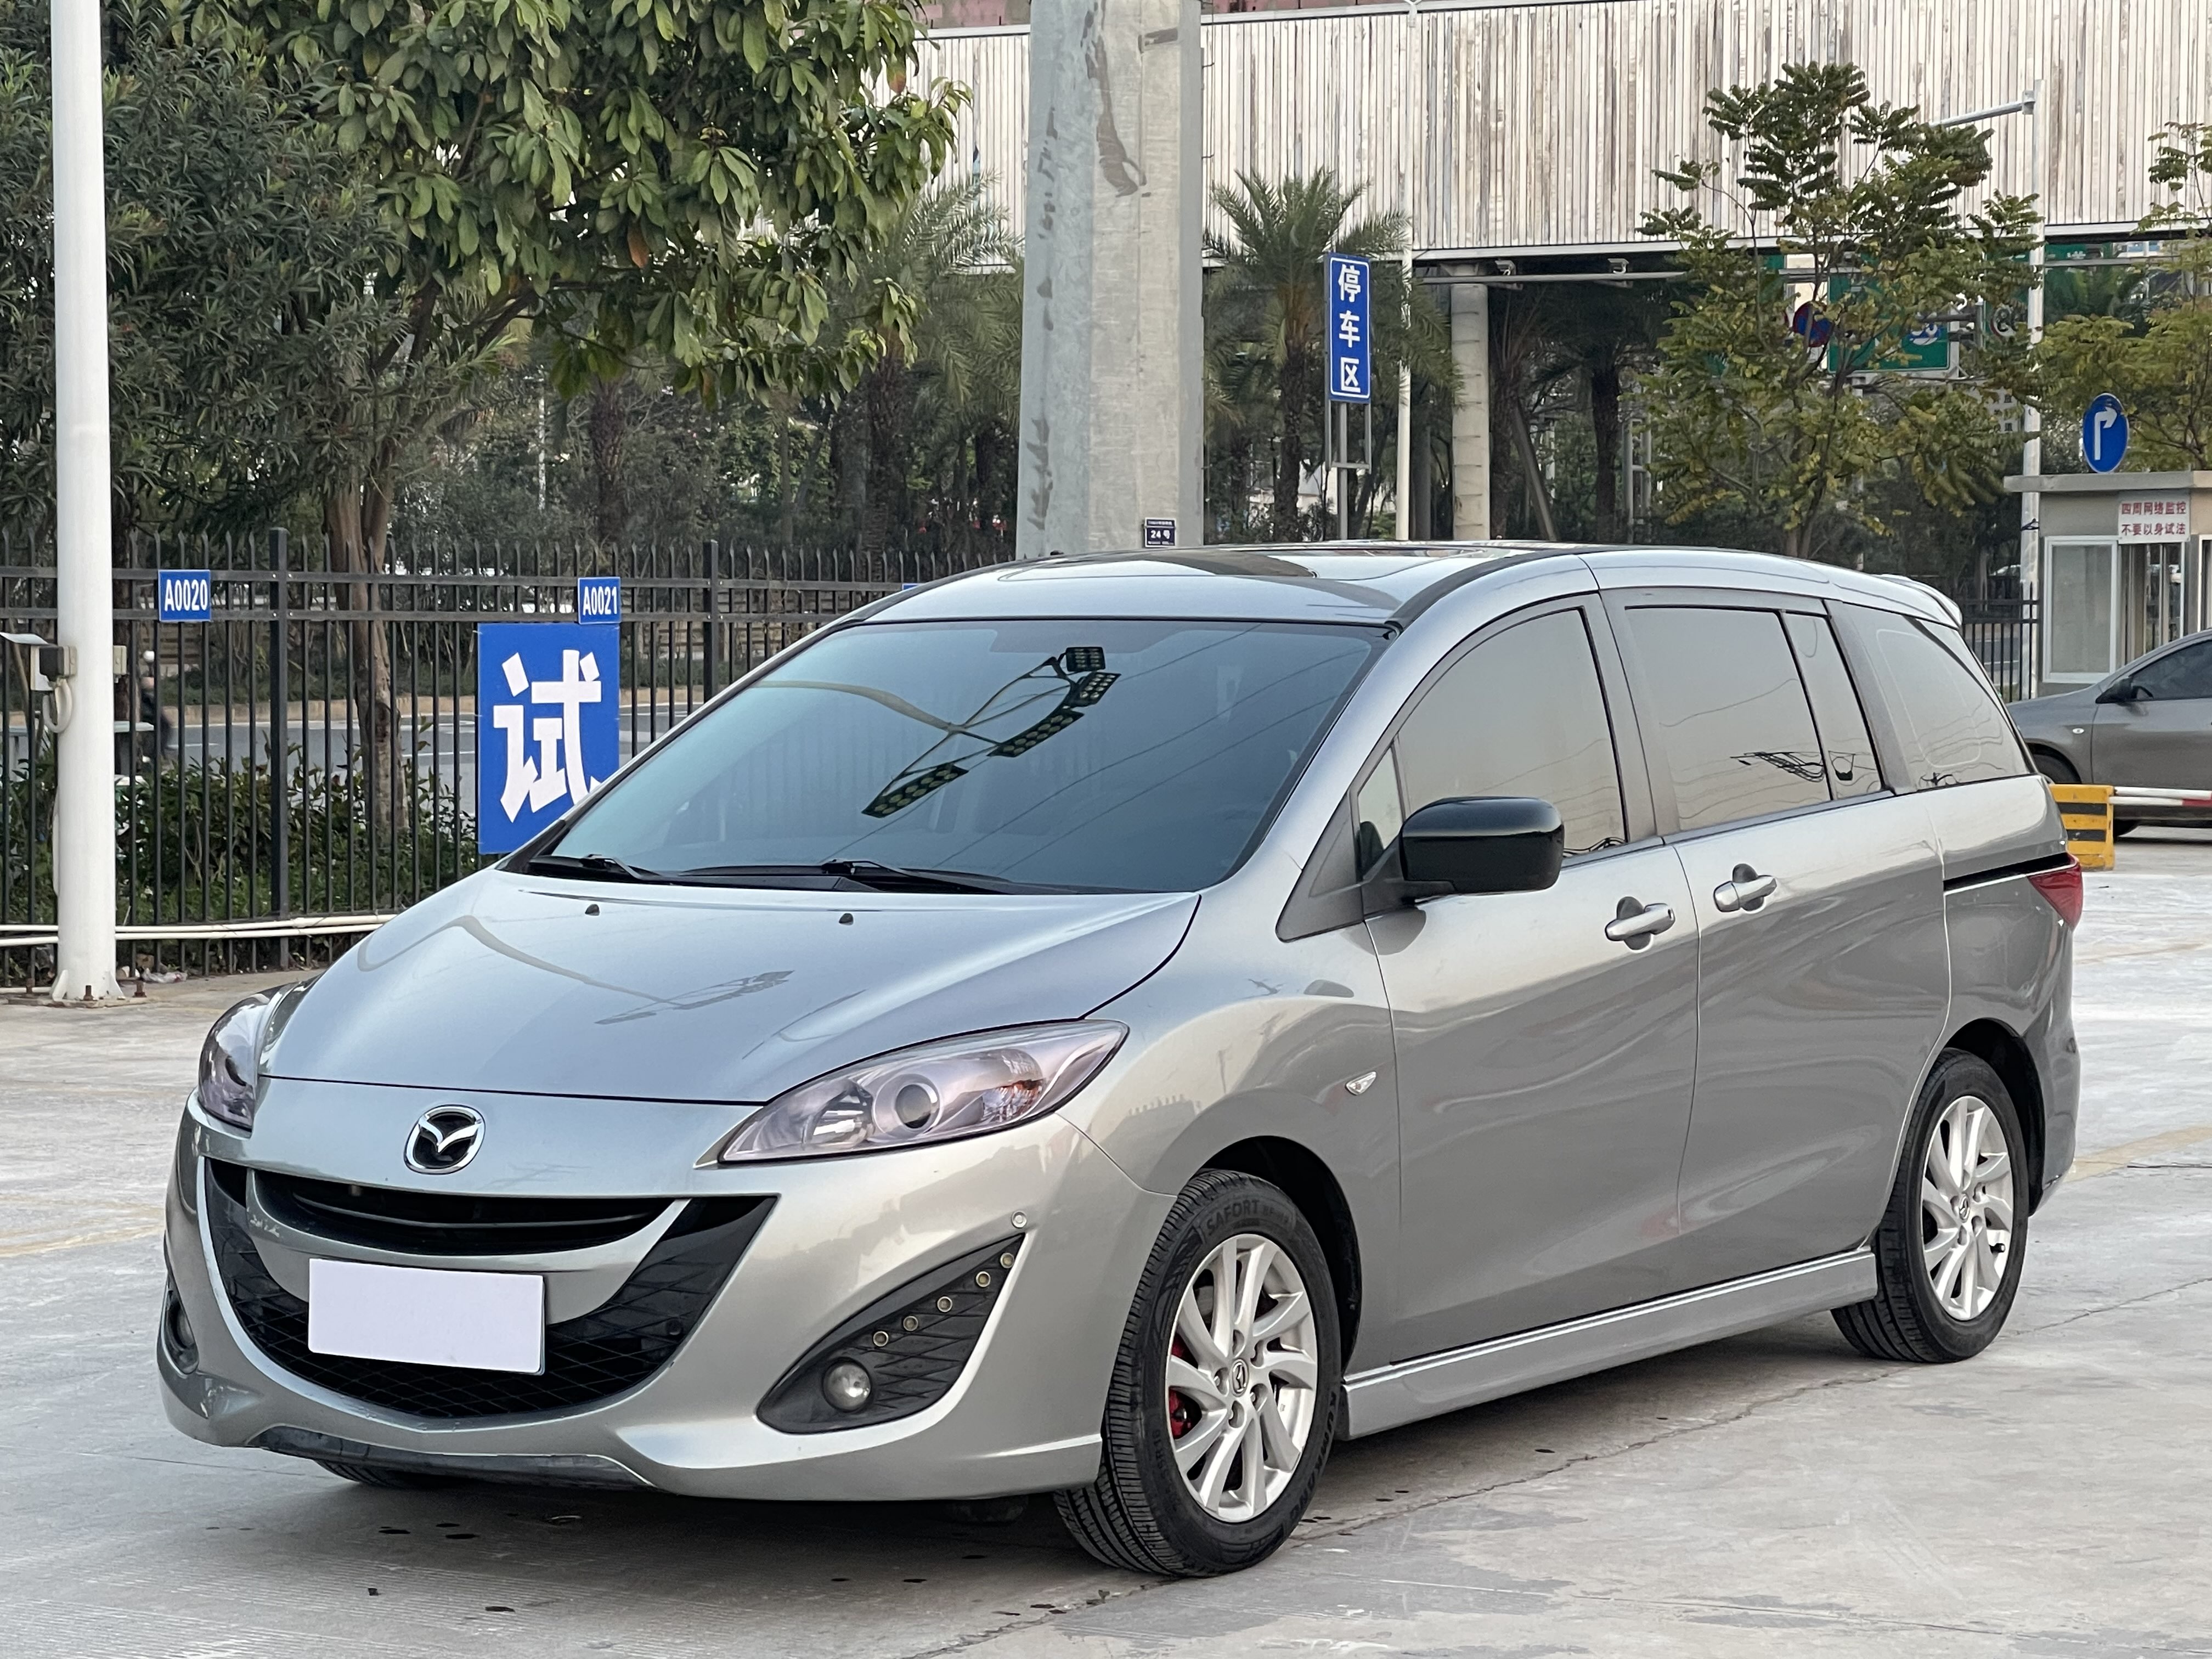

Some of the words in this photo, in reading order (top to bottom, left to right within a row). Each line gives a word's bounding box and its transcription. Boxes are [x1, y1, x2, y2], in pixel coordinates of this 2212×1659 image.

[1337, 264, 1362, 394] 停车区
[2121, 523, 2186, 536] 不要以身试法
[164, 579, 208, 612] A0020
[583, 585, 617, 616] A0021
[493, 649, 603, 823] 试
